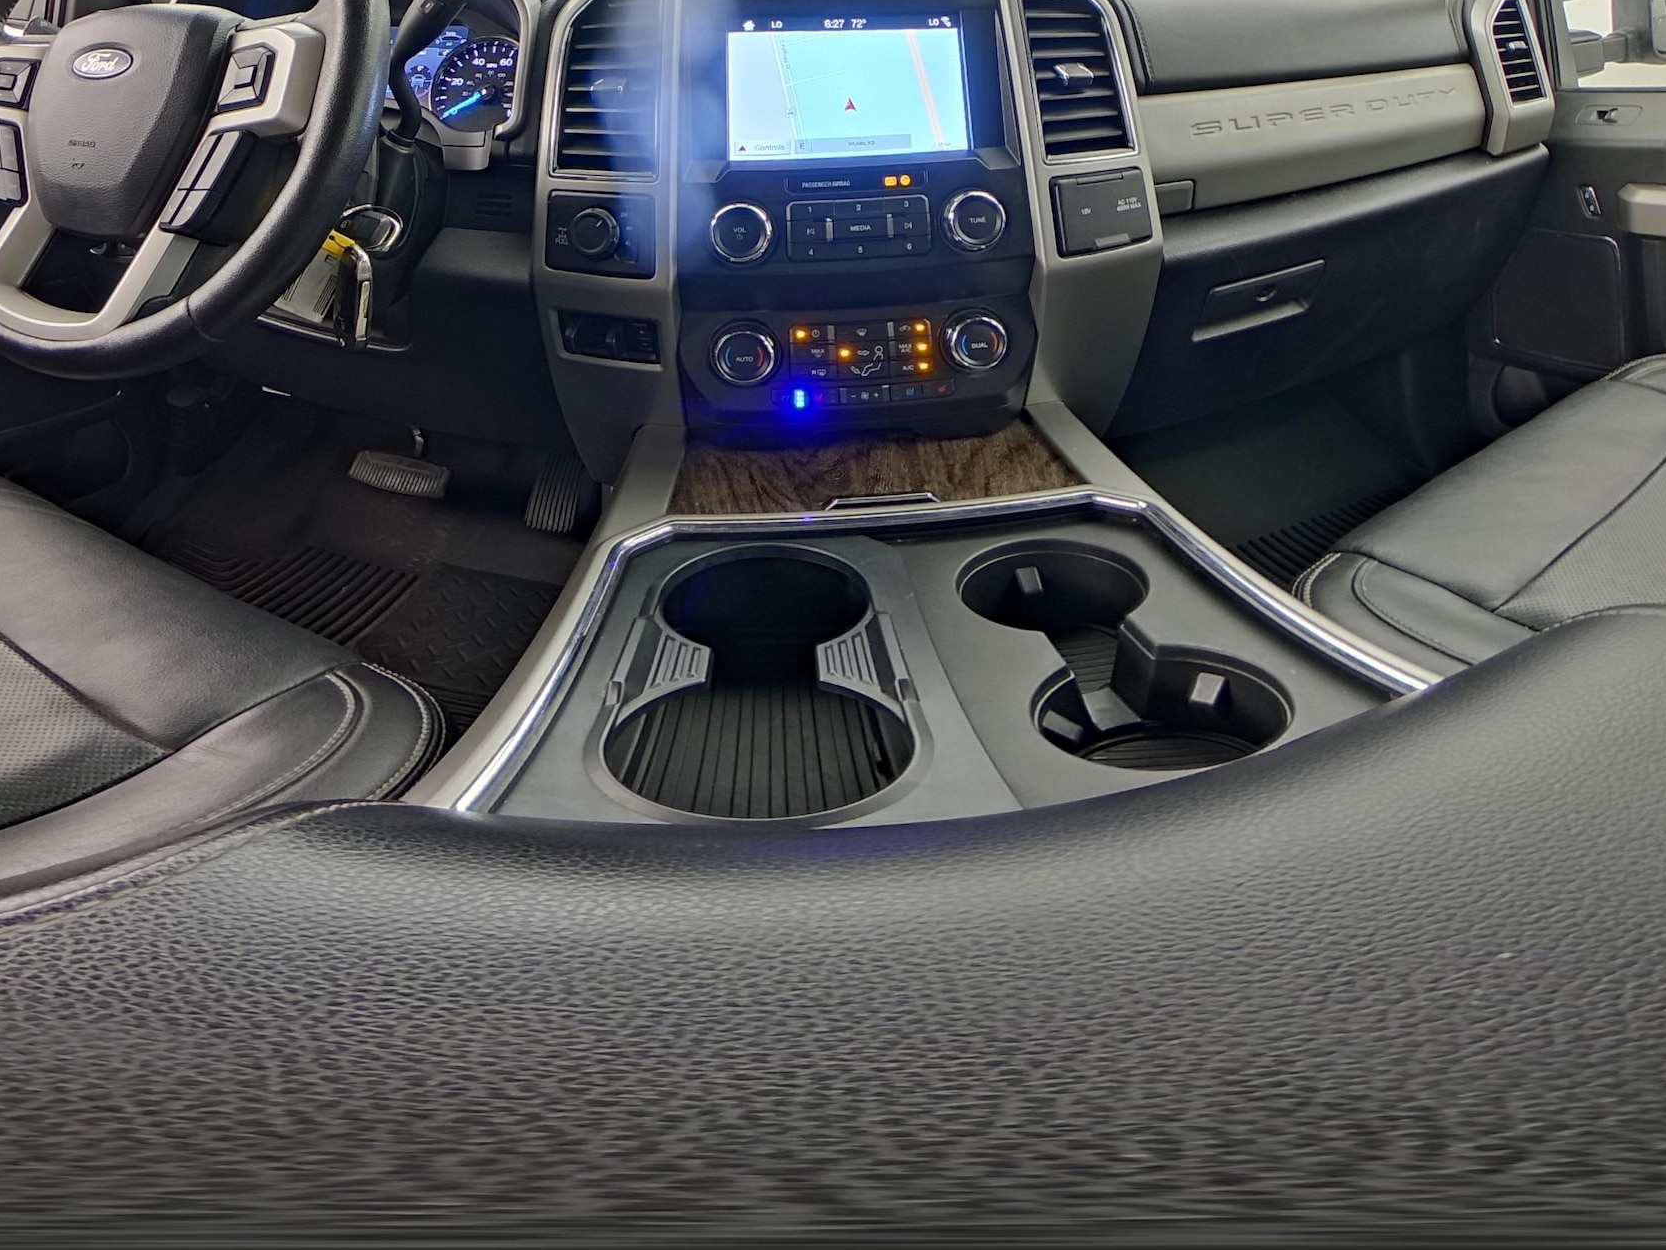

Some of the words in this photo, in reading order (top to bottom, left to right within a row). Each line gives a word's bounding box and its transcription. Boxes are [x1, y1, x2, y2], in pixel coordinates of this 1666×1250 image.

[771, 20, 783, 29] LO
[824, 19, 845, 29] 6:27
[928, 18, 939, 27] LO
[81, 53, 119, 72] Ford
[472, 58, 485, 66] 40
[500, 58, 513, 66] 60
[451, 78, 464, 86] 20
[1191, 103, 1355, 136] SUPER
[1365, 88, 1455, 112] DUTY
[802, 181, 831, 189] PASSENGER
[849, 224, 872, 232] MEDIA
[555, 237, 569, 245] PULL
